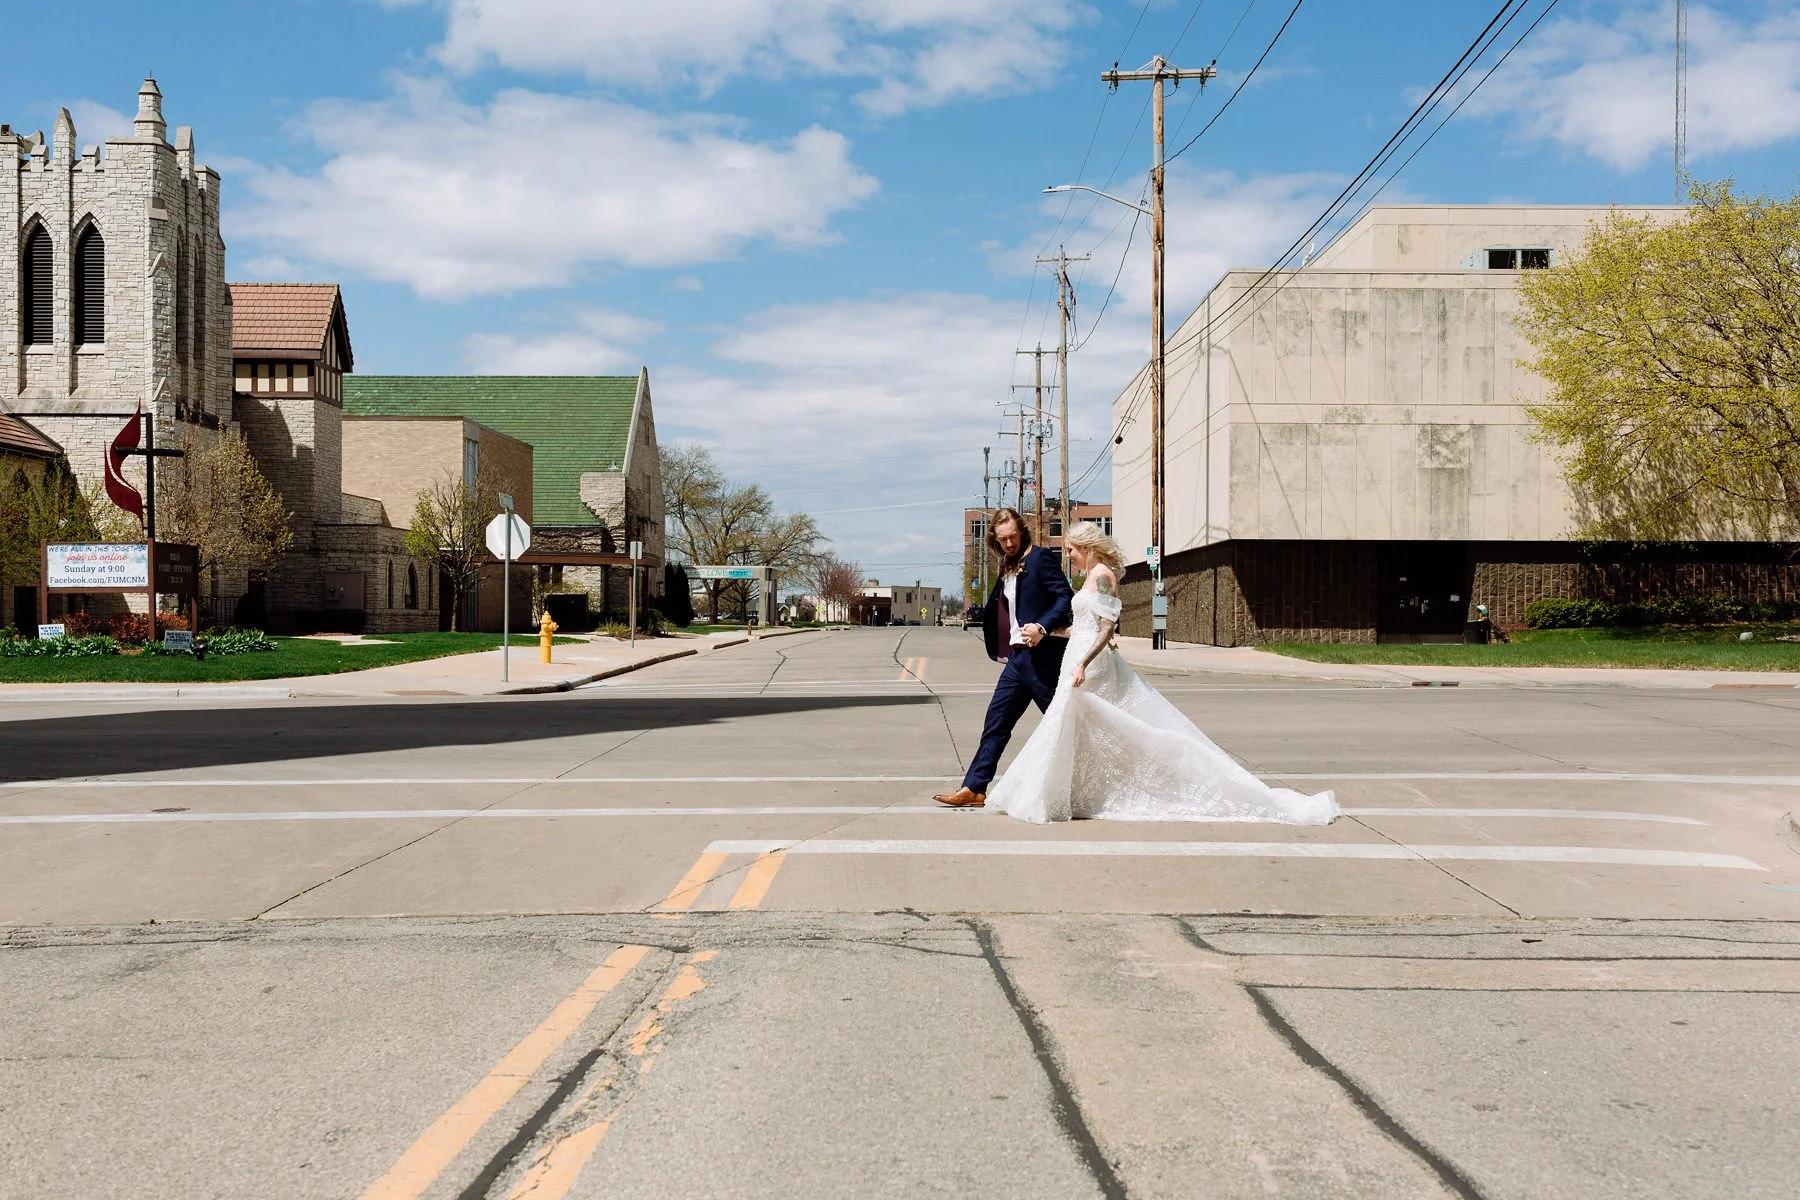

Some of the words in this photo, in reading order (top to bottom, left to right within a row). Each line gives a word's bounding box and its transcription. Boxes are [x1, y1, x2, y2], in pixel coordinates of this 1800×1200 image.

[66, 553, 85, 564] join
[99, 553, 128, 561] online
[64, 565, 96, 574] Sunday
[107, 565, 125, 573] 9:00
[49, 576, 146, 585] Facebook.com/FUMCNM
